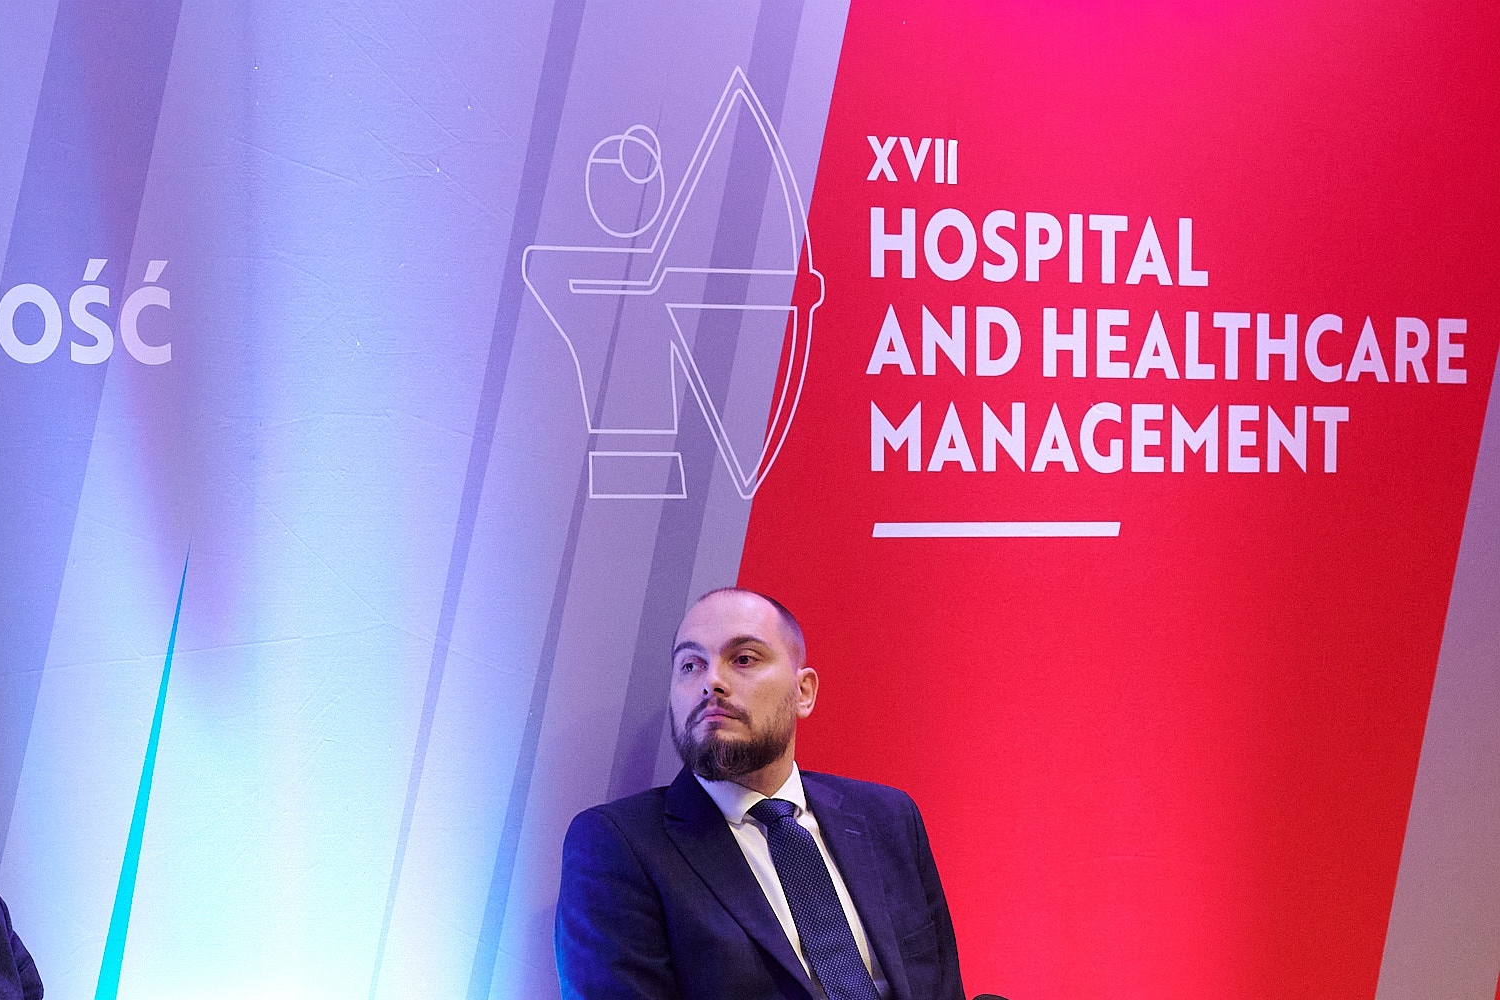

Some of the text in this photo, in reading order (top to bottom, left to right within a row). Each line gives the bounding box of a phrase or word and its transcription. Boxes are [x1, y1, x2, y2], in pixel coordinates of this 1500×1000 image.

[866, 135, 959, 185] XVII
[870, 206, 1209, 287] HOSPITAL
[865, 303, 1468, 384] AND HEALTHCARE
[870, 401, 1350, 474] MANAGEMENT
